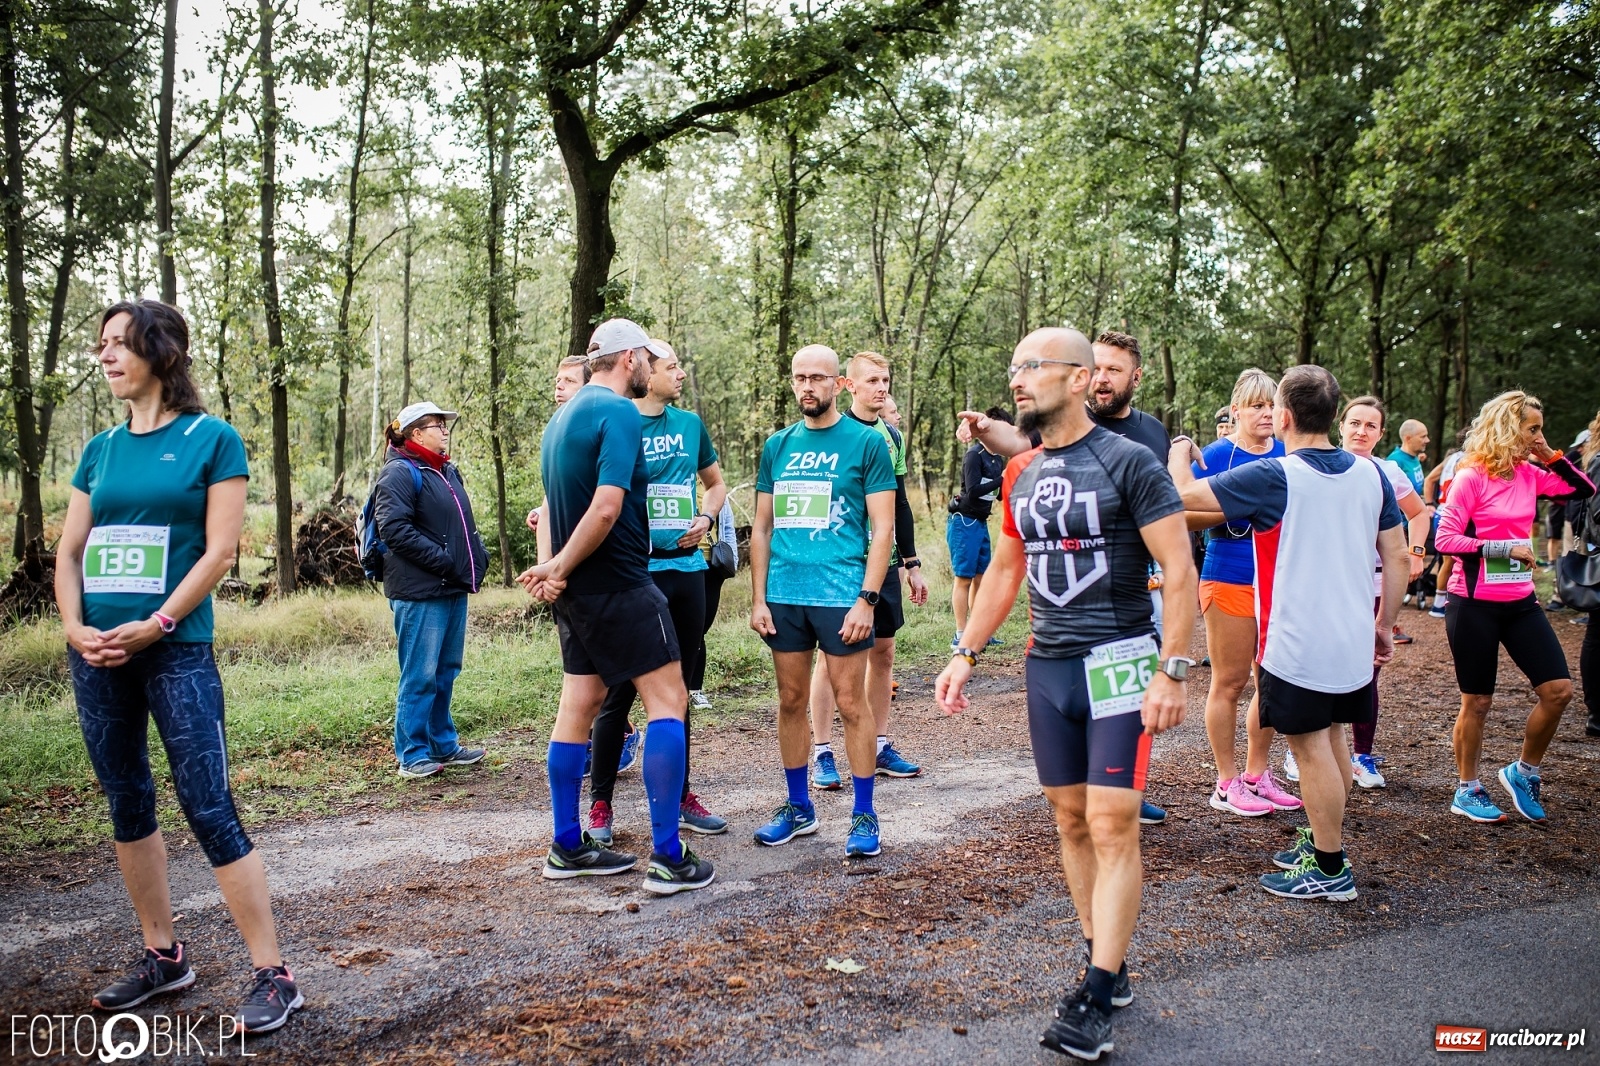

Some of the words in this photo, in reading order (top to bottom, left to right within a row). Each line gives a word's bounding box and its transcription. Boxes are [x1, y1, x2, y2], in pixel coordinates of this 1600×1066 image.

[642, 433, 684, 455] ZBM
[785, 451, 839, 470] ZBM
[824, 471, 839, 479] Team
[652, 498, 680, 518] 98
[786, 496, 812, 516] 57
[1046, 540, 1055, 551] &
[97, 547, 146, 575] 139
[1102, 658, 1154, 697] 126
